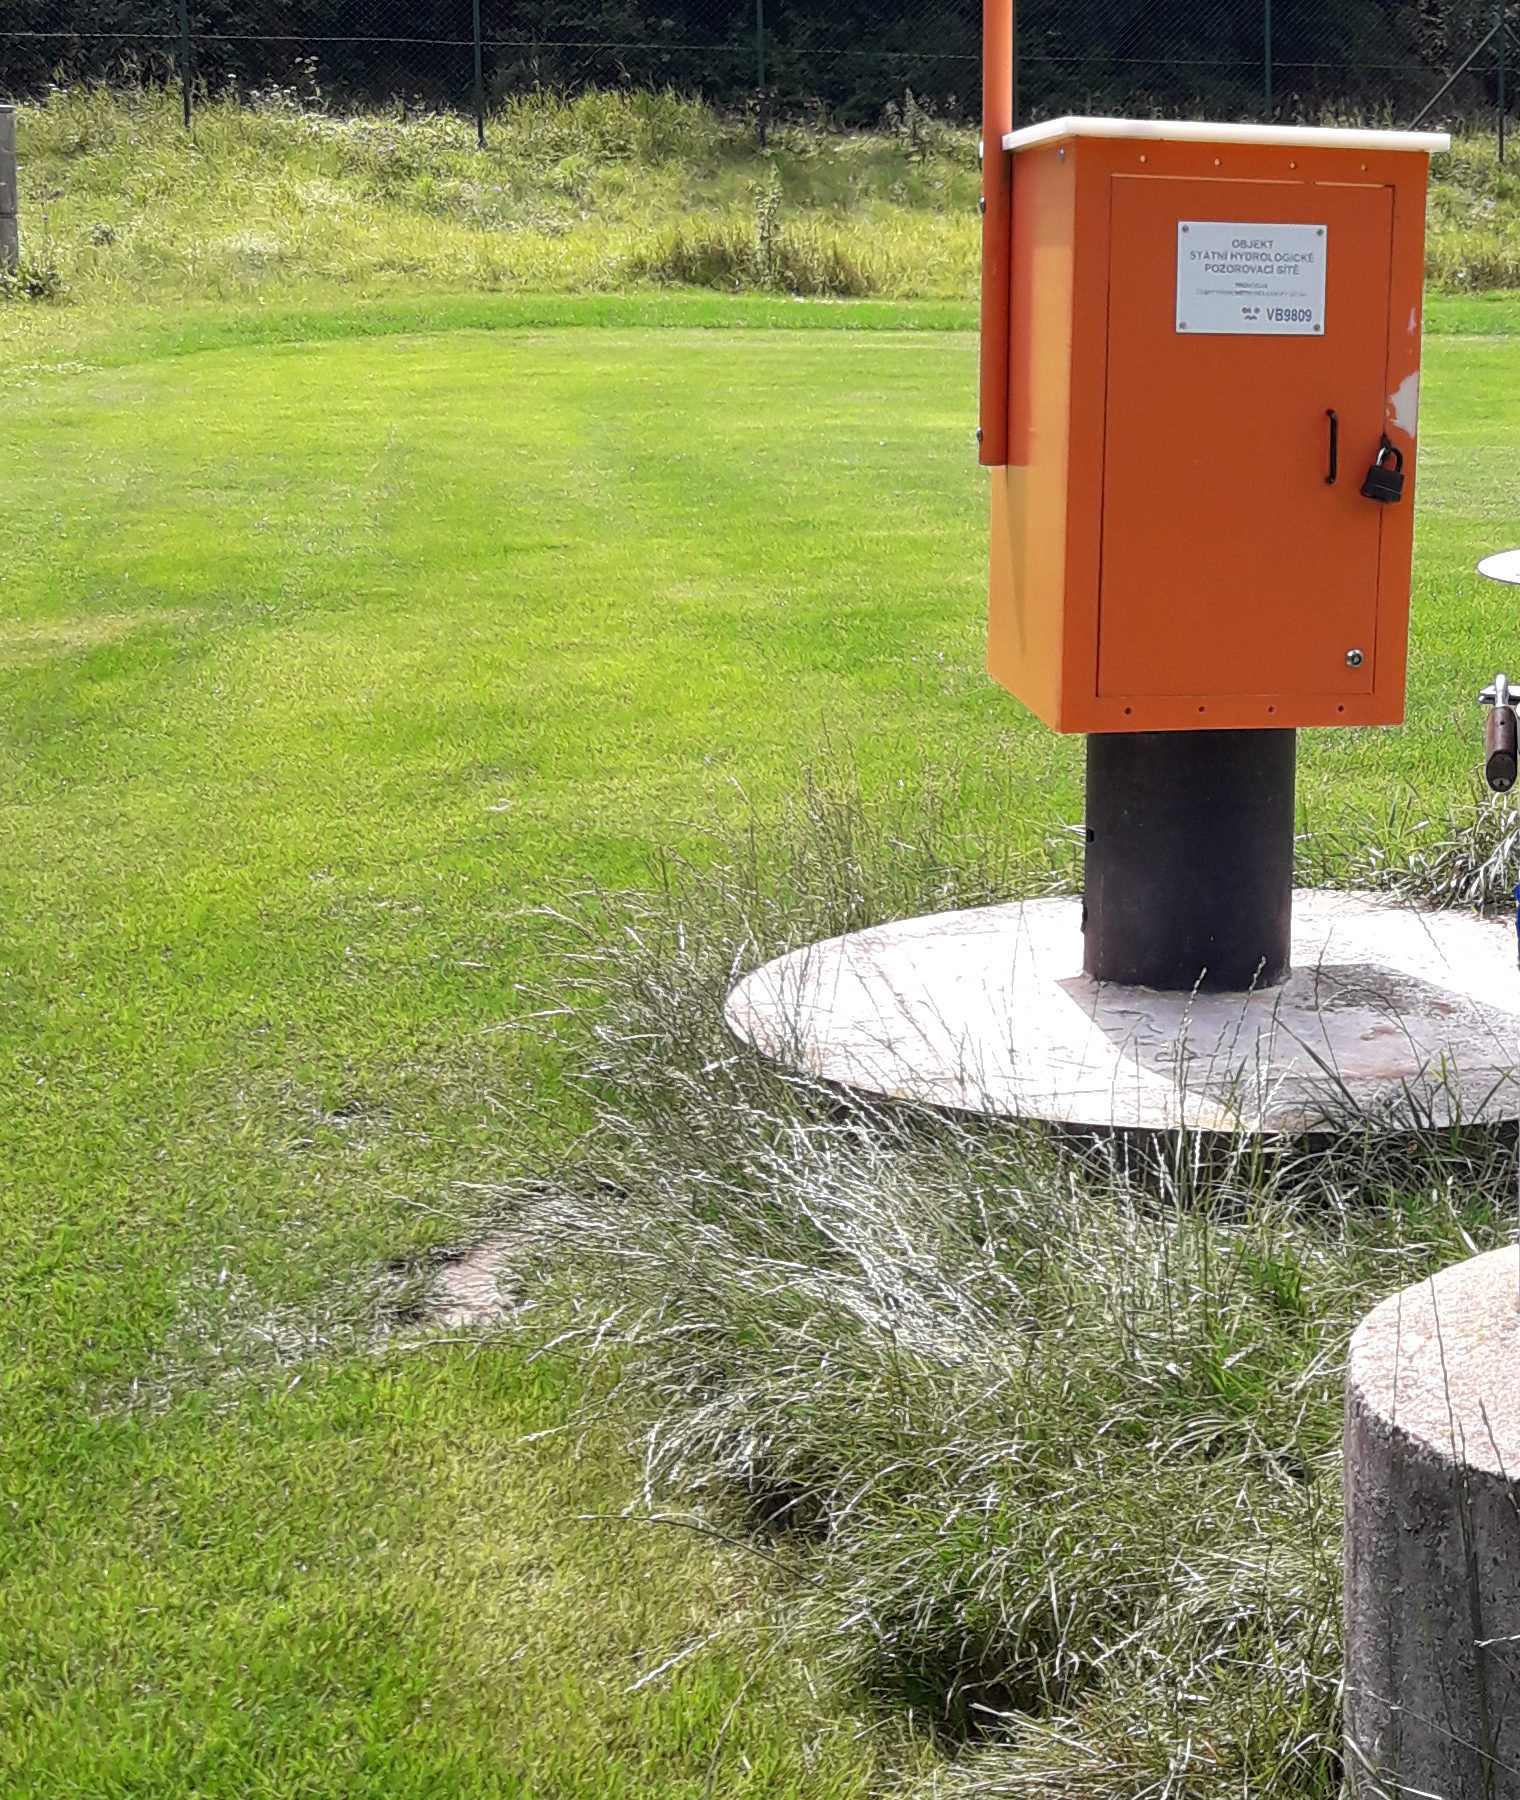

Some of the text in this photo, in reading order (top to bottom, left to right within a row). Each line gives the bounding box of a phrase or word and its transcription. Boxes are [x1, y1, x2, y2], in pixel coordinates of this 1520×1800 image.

[1231, 238, 1274, 250] OBJEKT
[1204, 262, 1274, 275] POZOROVACÍ
[1266, 307, 1313, 323] VB9809
